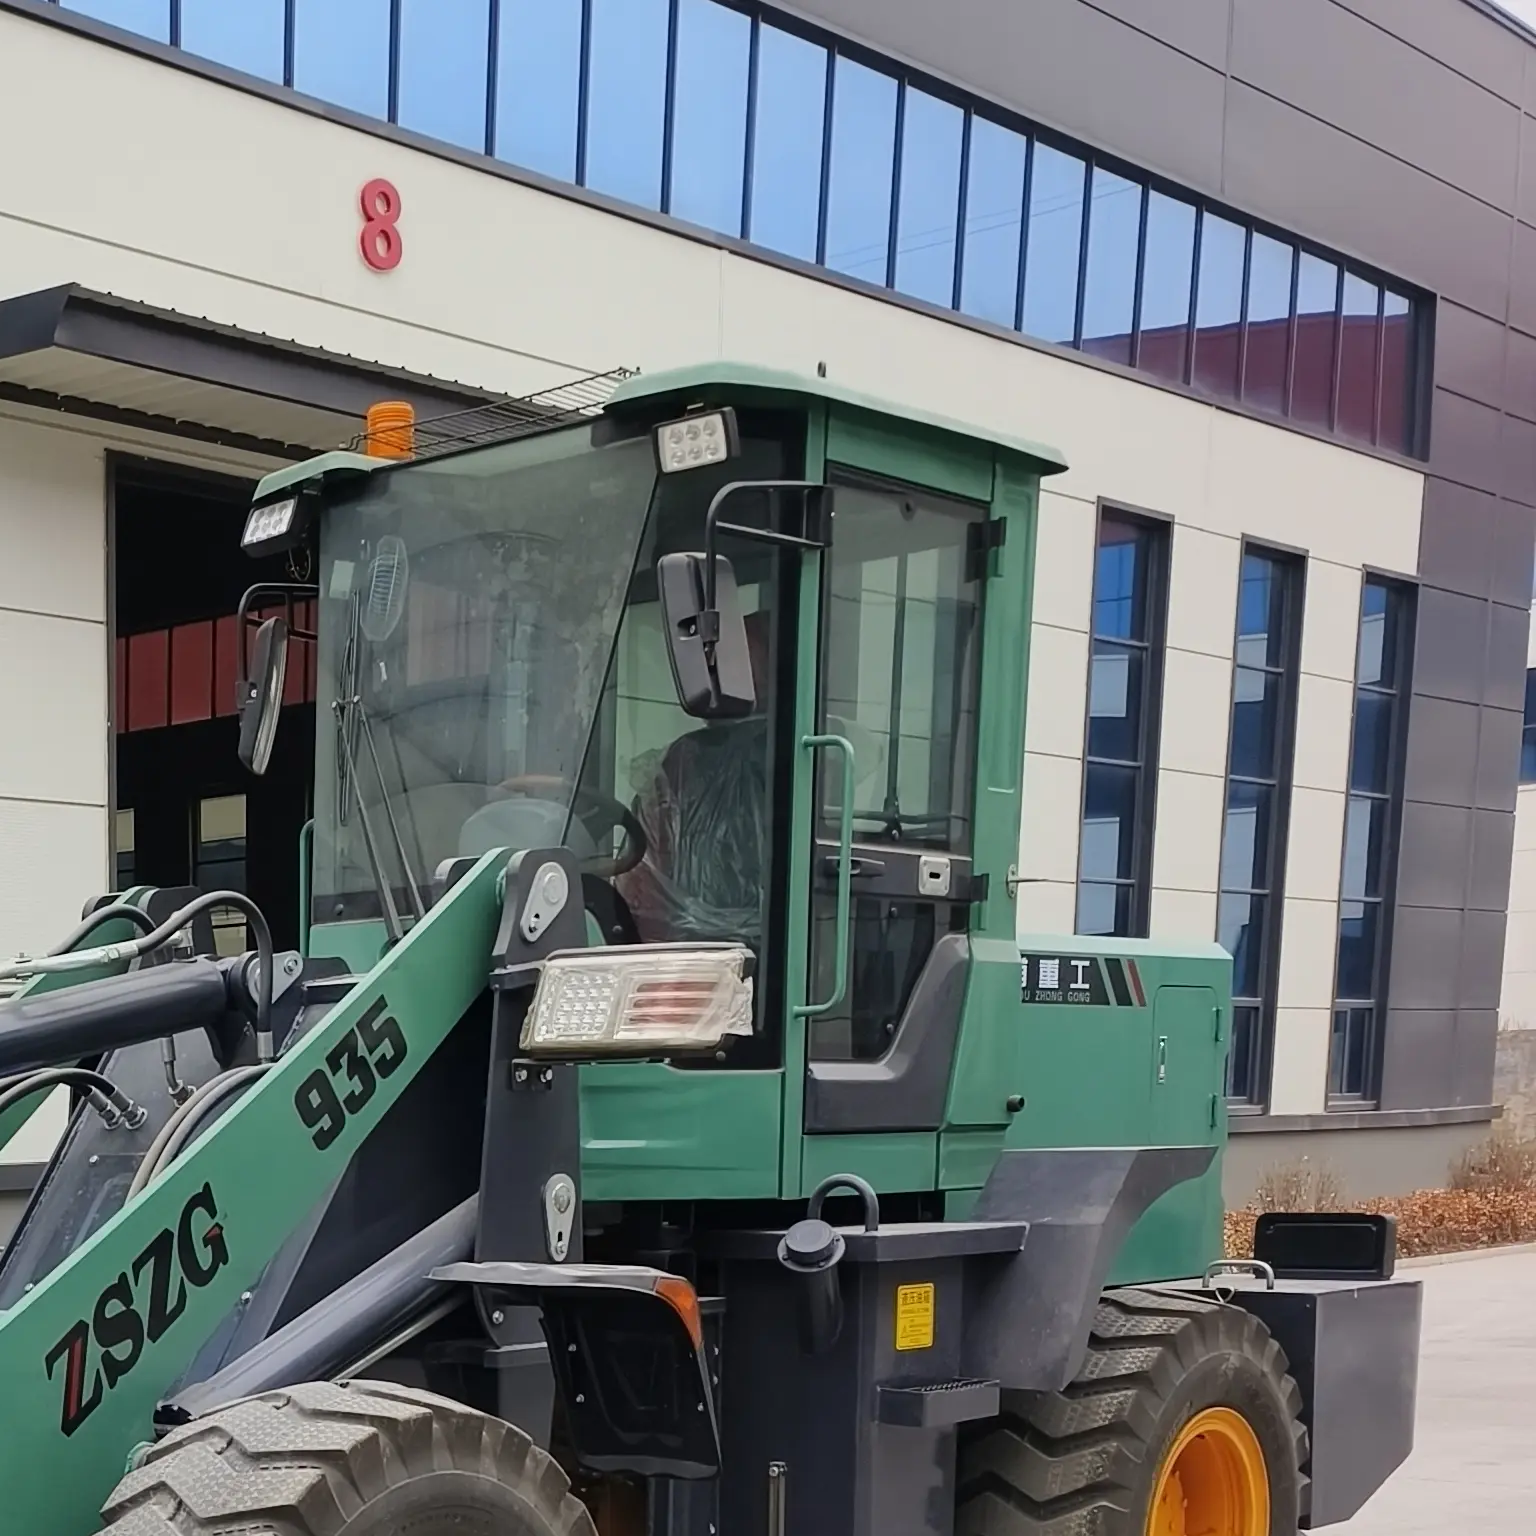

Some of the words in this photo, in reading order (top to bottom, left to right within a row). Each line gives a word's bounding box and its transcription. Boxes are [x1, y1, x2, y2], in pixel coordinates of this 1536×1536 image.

[360, 178, 402, 270] 8
[1035, 990, 1063, 1002] ZHONG
[1067, 991, 1091, 1003] GONG
[294, 994, 407, 1151] 935
[44, 1182, 229, 1437] ZSZG
